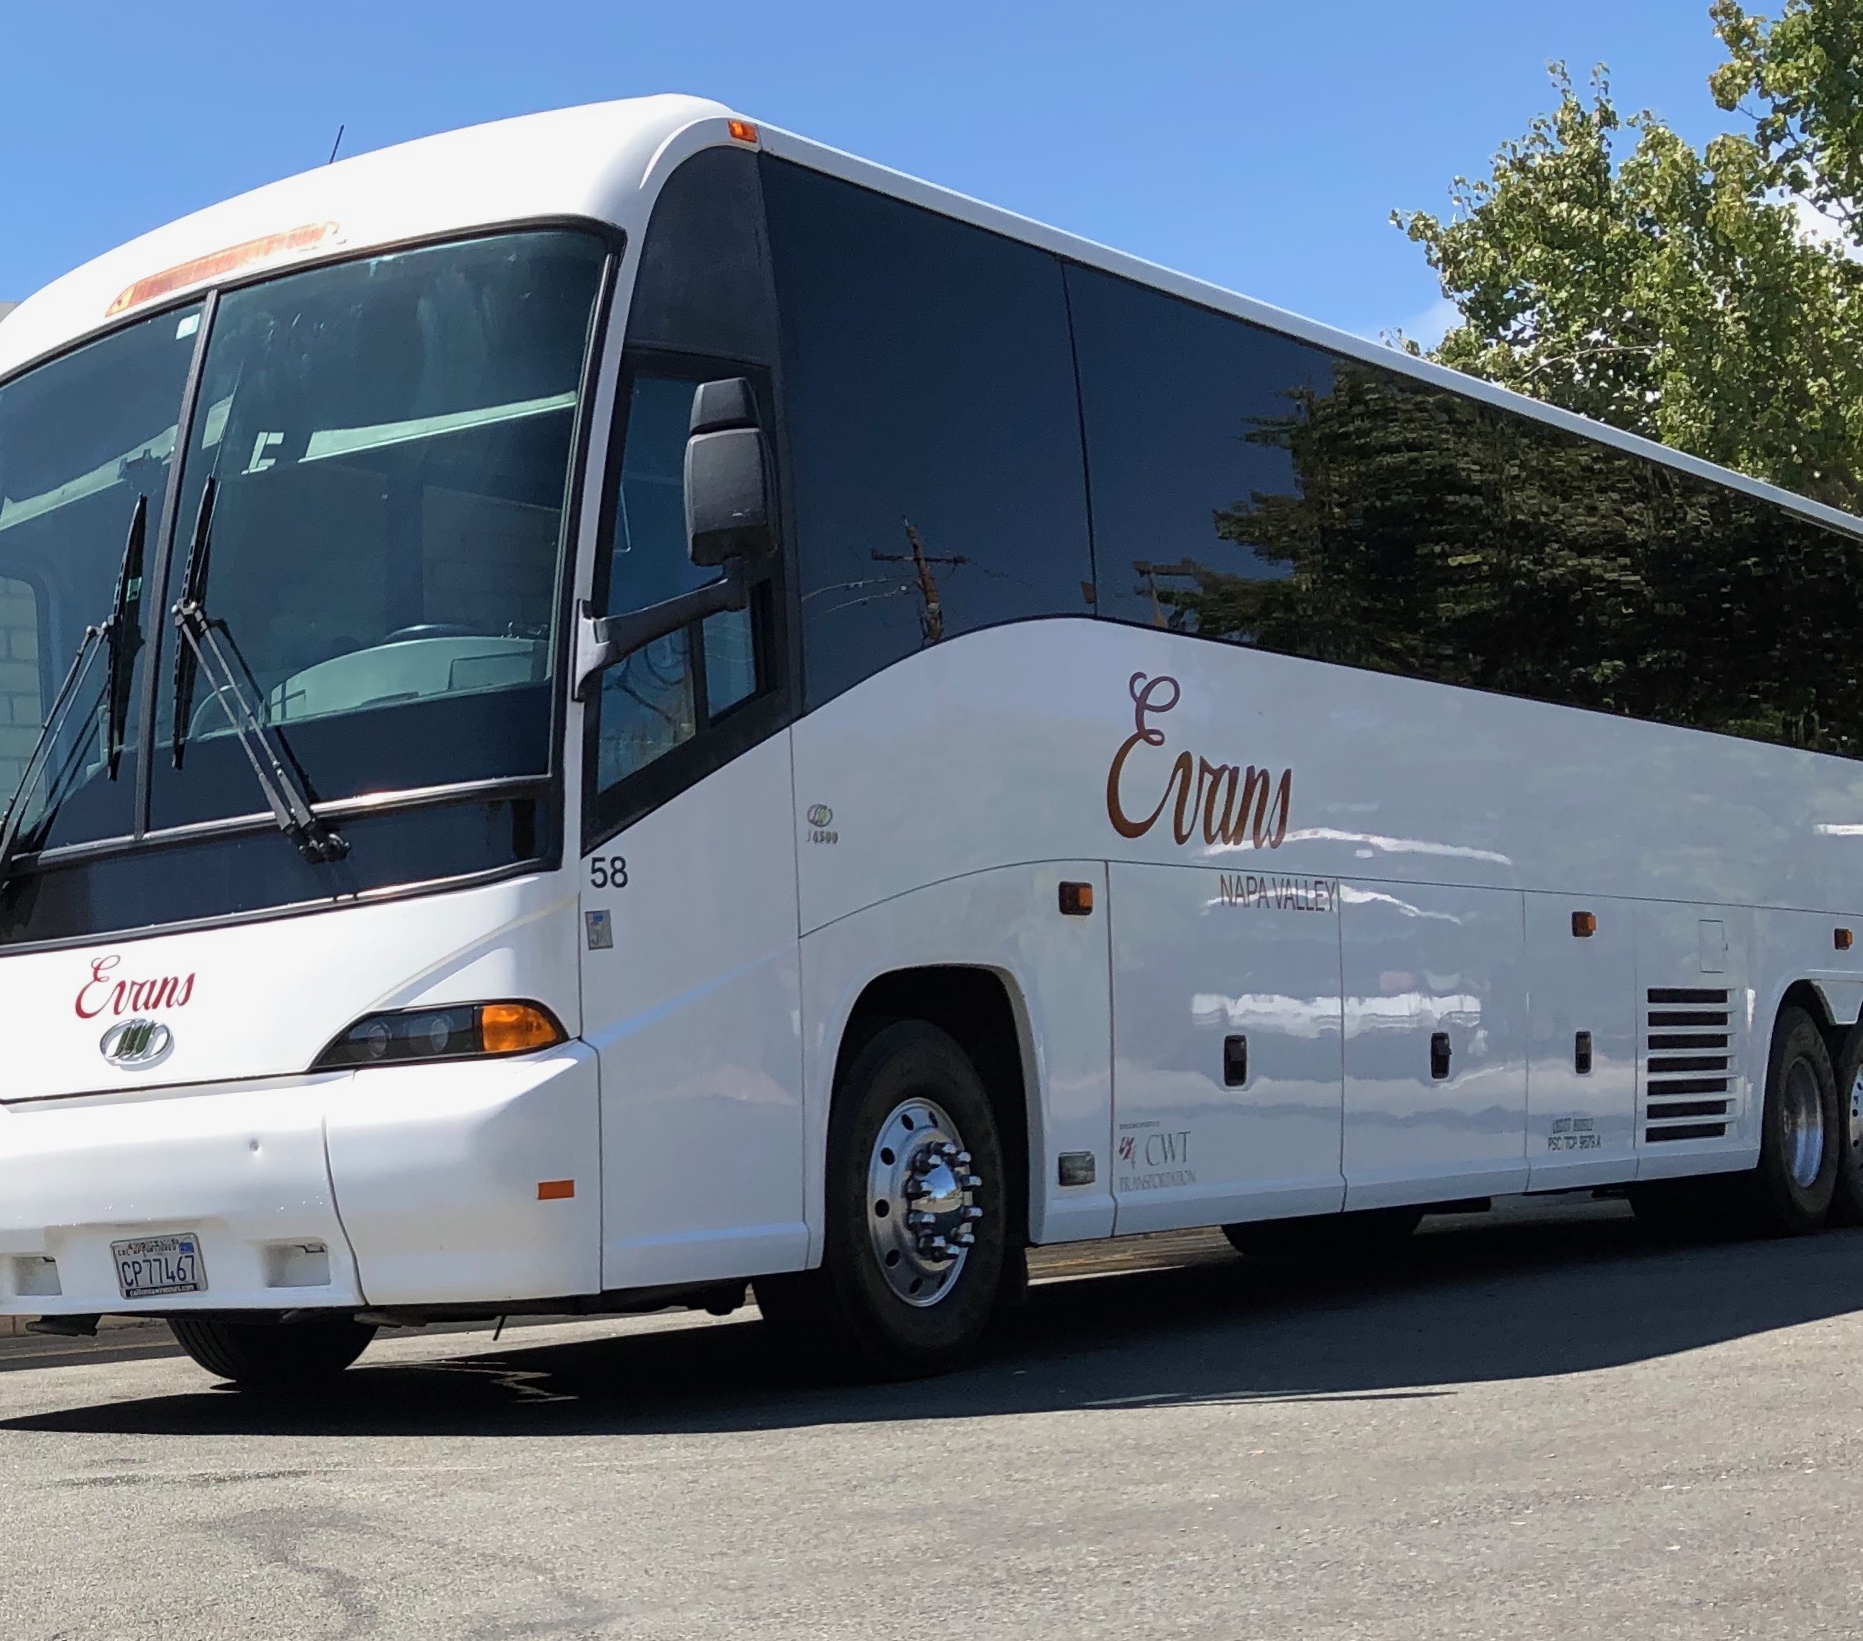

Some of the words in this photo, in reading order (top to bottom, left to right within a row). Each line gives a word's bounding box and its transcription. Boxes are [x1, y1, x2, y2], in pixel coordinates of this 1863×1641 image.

[1106, 671, 1292, 850] Evans
[590, 855, 628, 889] 58
[1220, 874, 1270, 909] NAPA
[1272, 877, 1336, 912] VALLEY
[75, 954, 196, 1019] Evans
[1145, 1130, 1191, 1167] CWT
[121, 1254, 195, 1287] CP77467
